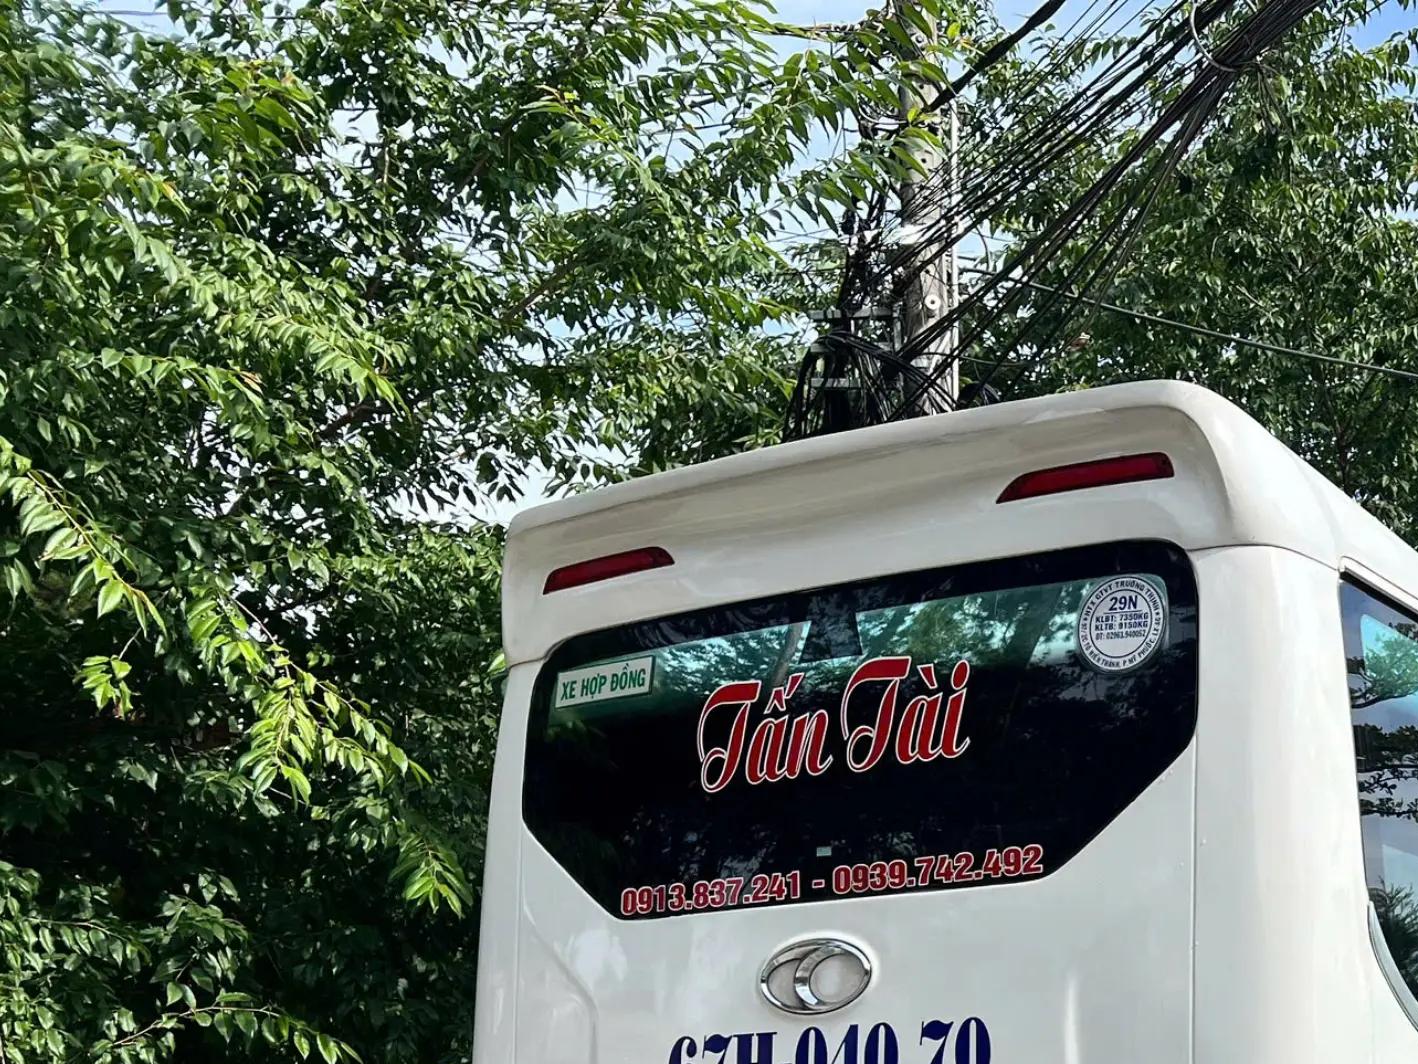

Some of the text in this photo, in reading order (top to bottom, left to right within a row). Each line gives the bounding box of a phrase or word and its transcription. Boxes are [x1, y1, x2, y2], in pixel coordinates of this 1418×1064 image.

[1108, 595, 1138, 611] 29N
[1094, 622, 1116, 631] KLTB:
[1095, 612, 1149, 623] KLBT: 7350KG
[561, 662, 646, 701] XE HỢP ĐỒNG
[696, 656, 971, 793] Tấn Tài
[620, 844, 1044, 916] 0913.837.241 - 0939.742.492
